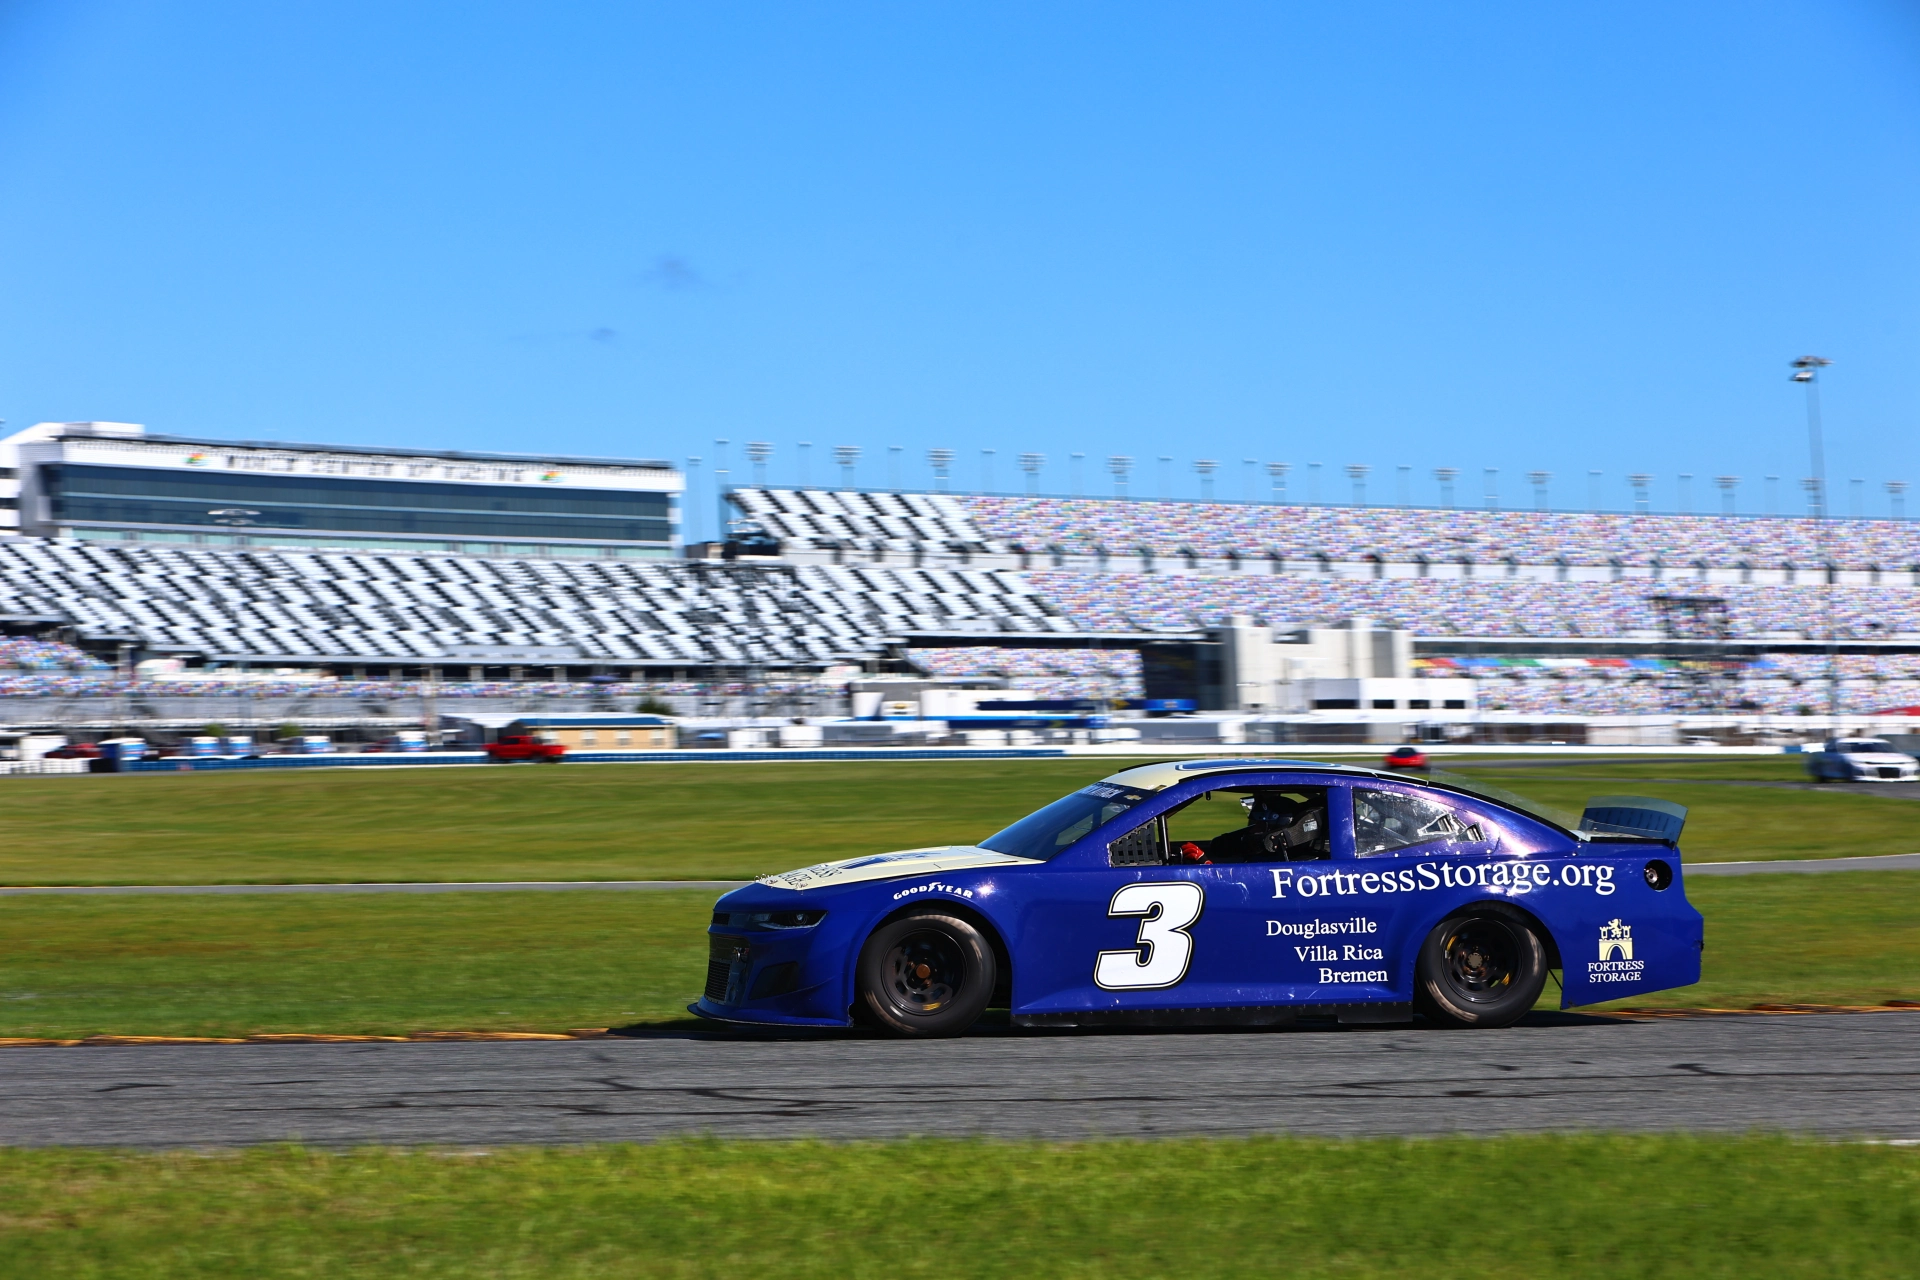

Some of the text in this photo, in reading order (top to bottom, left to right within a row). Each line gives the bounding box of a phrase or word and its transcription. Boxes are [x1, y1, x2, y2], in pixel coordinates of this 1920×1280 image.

[892, 881, 973, 900] GOODYEAR
[1268, 862, 1615, 900] FortressStorage.org
[1093, 880, 1205, 990] 3
[1265, 917, 1377, 940] Douglasville
[1294, 944, 1384, 963] Villa Rica
[1318, 968, 1389, 984] Bremen
[1587, 960, 1645, 973] FORTRESS
[1589, 972, 1642, 983] STORAGE
